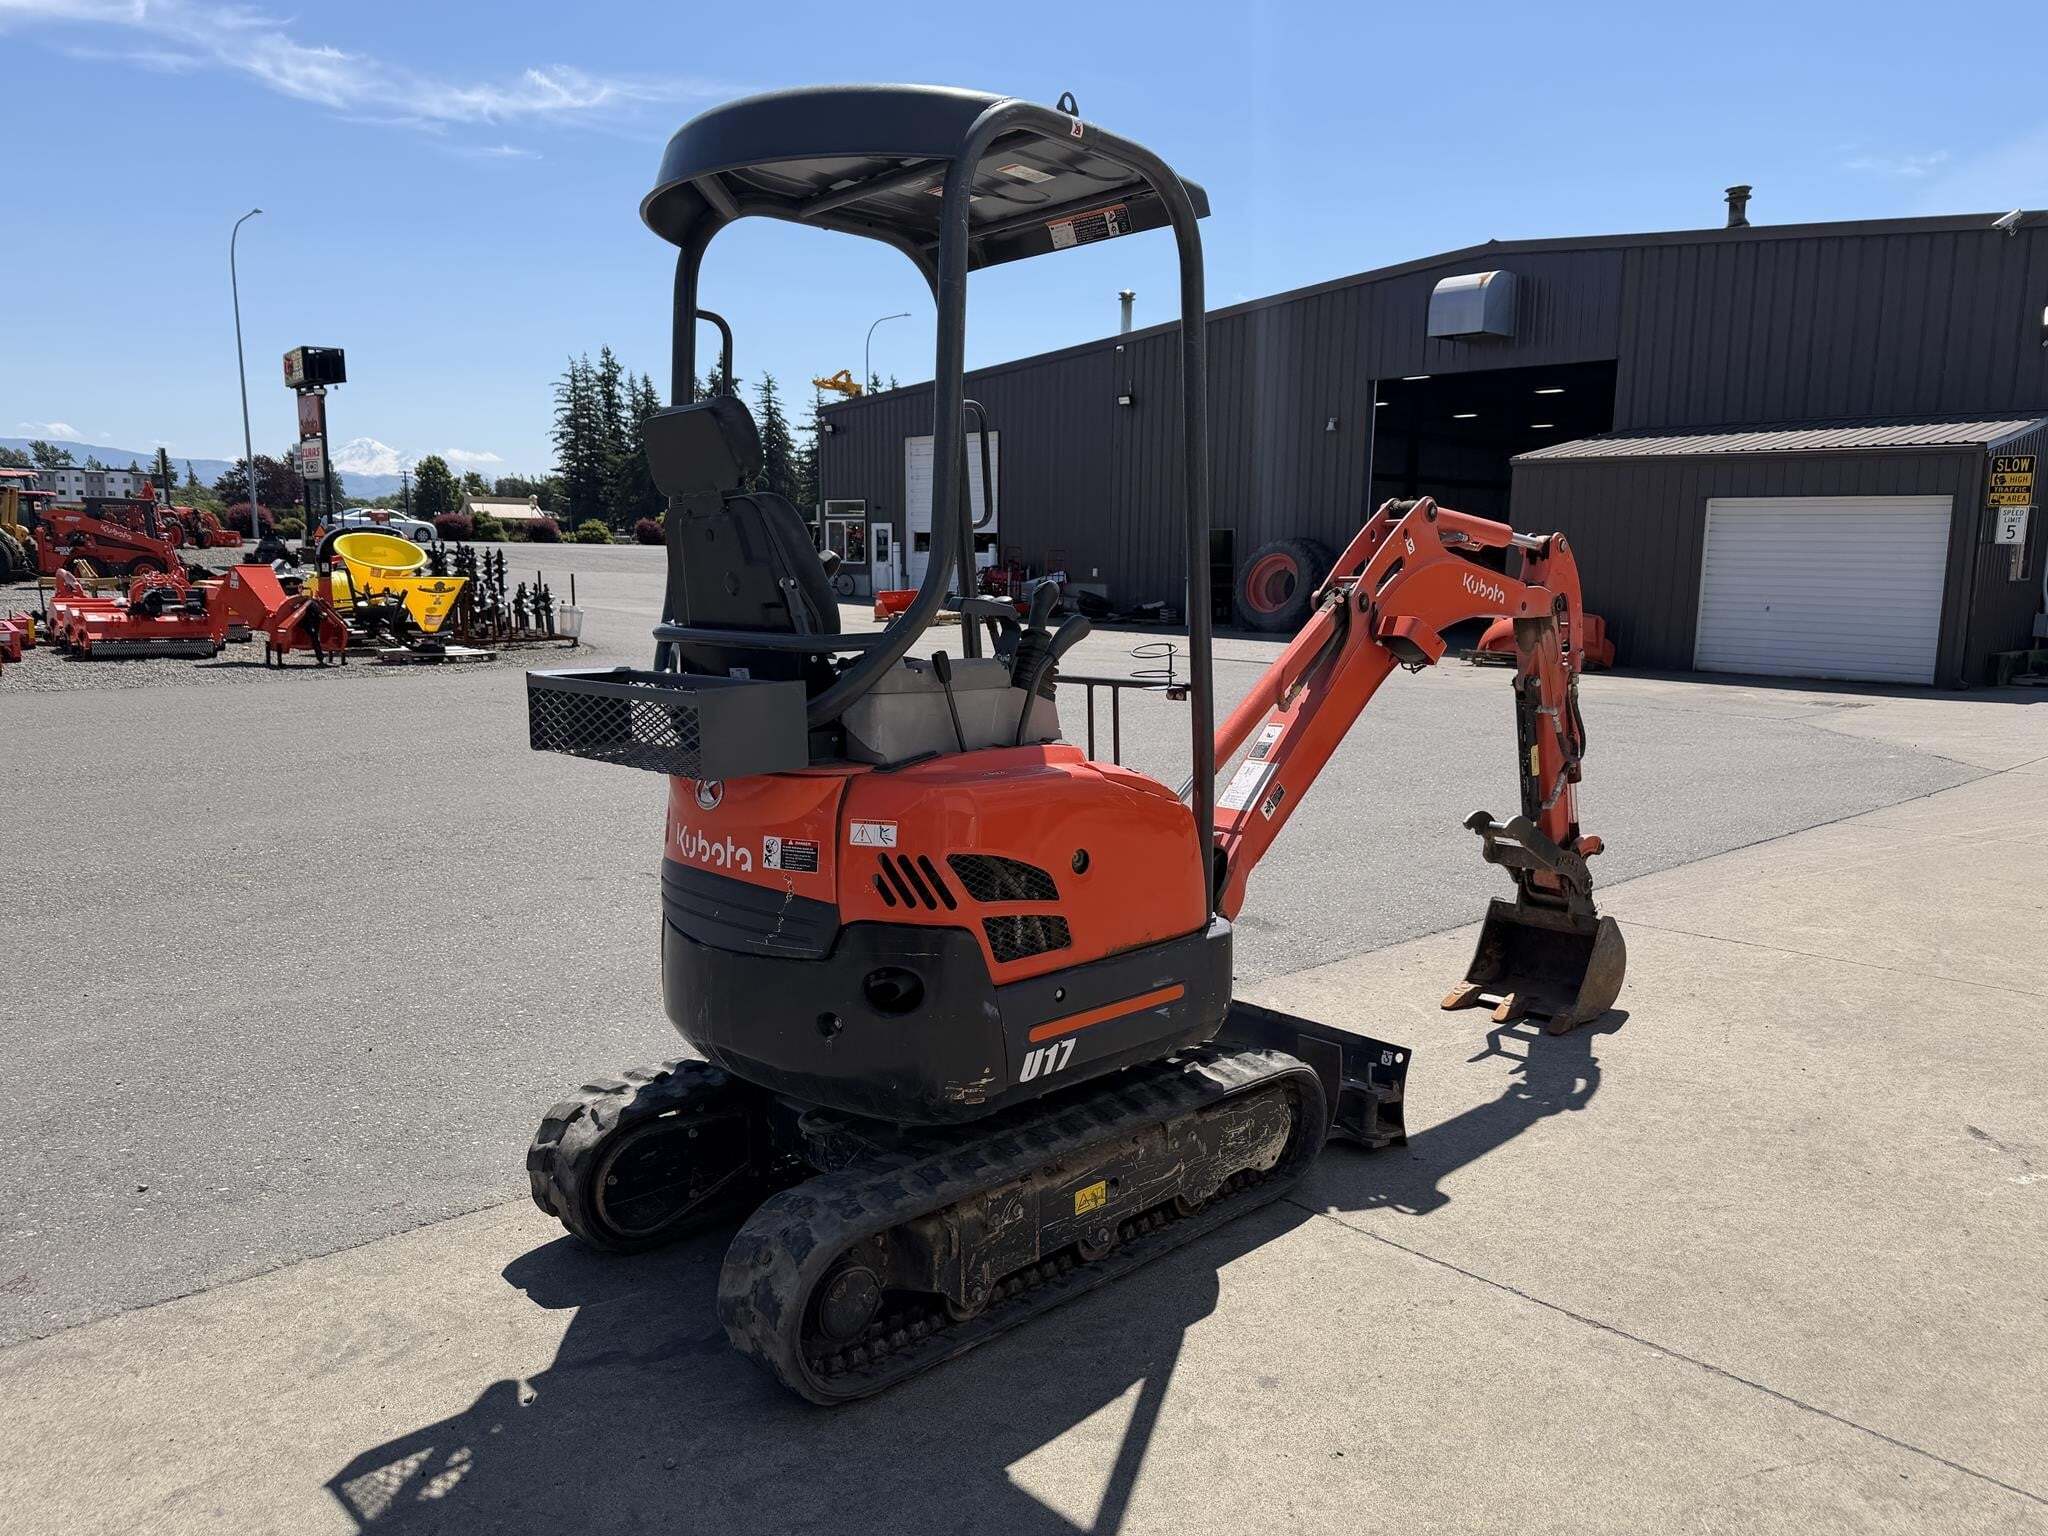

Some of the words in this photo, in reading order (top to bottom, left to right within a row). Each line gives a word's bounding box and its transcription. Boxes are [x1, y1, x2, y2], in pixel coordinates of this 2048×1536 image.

[1997, 458, 2030, 472] SLOW
[2009, 475, 2028, 484] HIGH
[2006, 495, 2026, 503] AREA
[100, 523, 132, 540] Kubota
[2006, 525, 2016, 539] 5
[1462, 572, 1505, 604] Kubota
[676, 822, 752, 872] Kubota
[1020, 1037, 1077, 1083] U17
